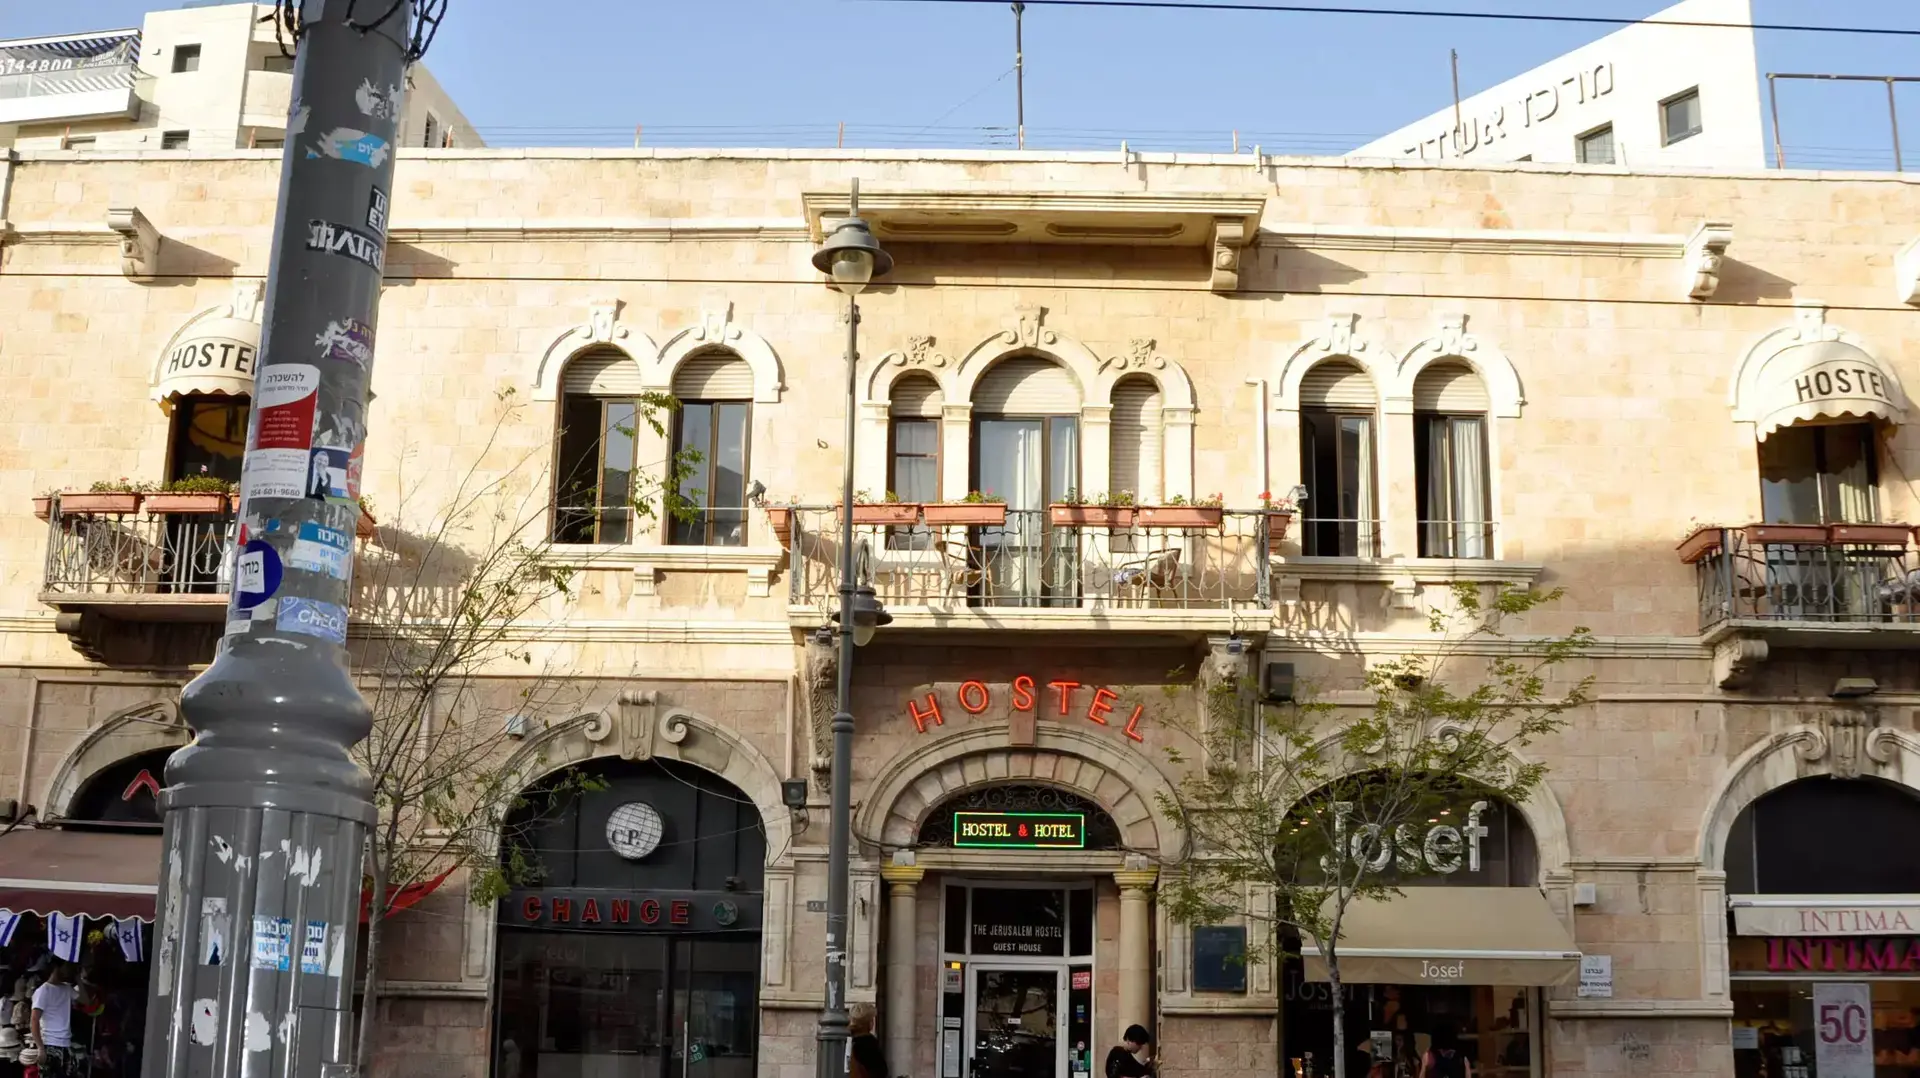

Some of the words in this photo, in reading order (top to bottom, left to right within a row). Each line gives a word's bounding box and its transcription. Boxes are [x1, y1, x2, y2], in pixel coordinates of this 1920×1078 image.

[266, 372, 305, 383] להשכרה
[1795, 368, 1892, 401] HOSTEL
[907, 675, 1145, 743] HOSTEL
[962, 823, 1011, 837] HOSTEL
[1018, 823, 1029, 837] &
[1034, 824, 1075, 838] HOTEL
[1319, 800, 1489, 875] Josef
[522, 896, 690, 925] CHANGE
[1799, 910, 1913, 932] INTIMA
[973, 924, 987, 935] THE
[989, 925, 1032, 937] JERUSALEM
[1035, 926, 1062, 938] HOSTEL
[993, 942, 1016, 952] GUEST
[1019, 943, 1042, 953] HOUSE
[1766, 937, 1920, 972] INTIMA
[1420, 960, 1464, 978] Josef
[1820, 1004, 1867, 1043] 50
